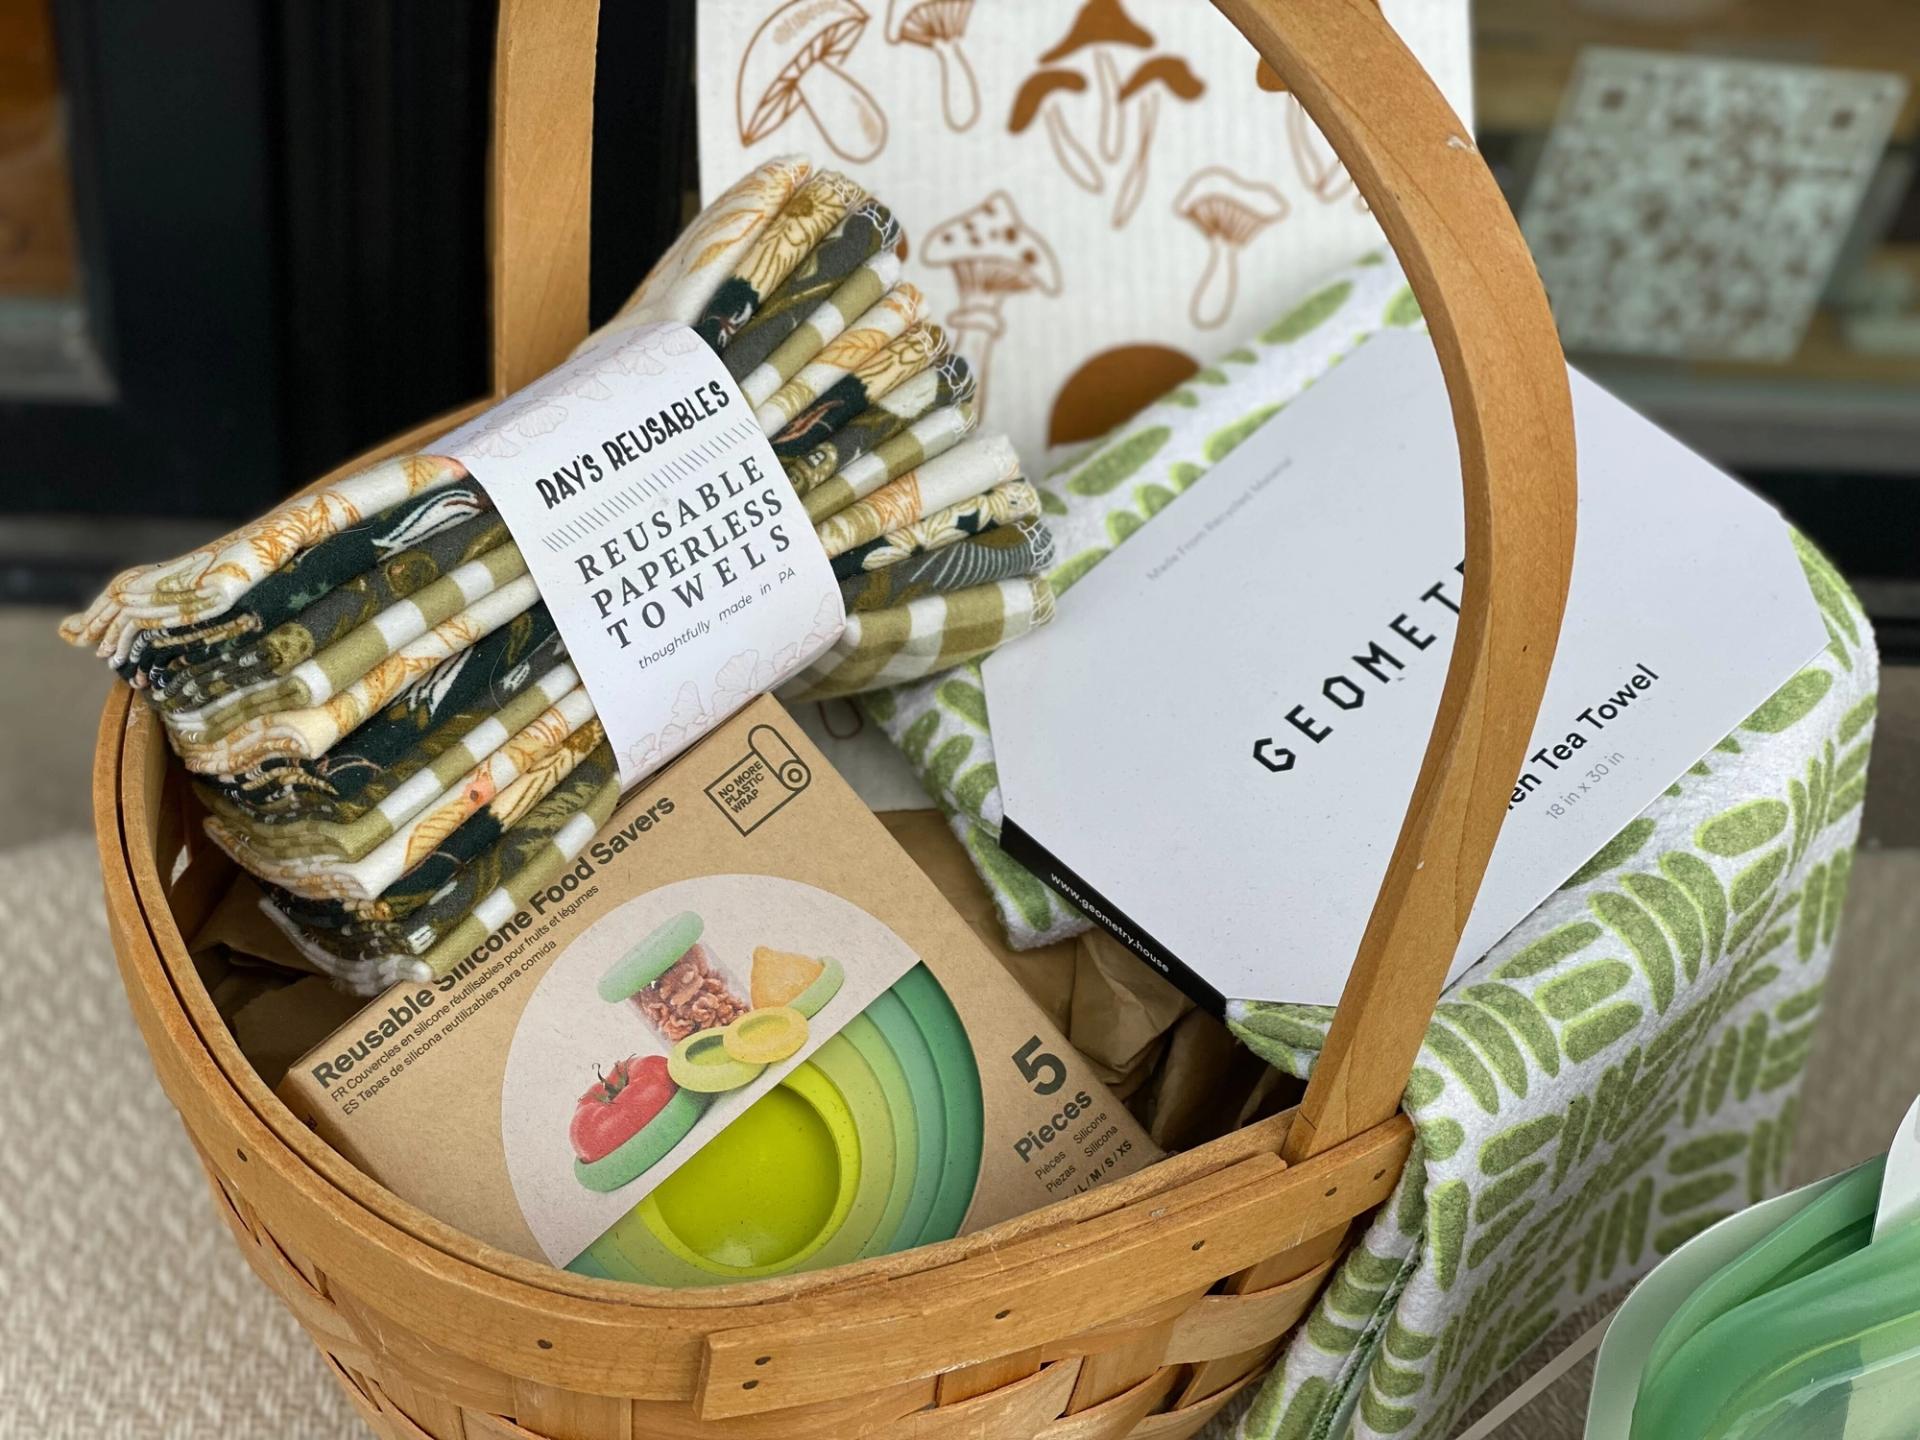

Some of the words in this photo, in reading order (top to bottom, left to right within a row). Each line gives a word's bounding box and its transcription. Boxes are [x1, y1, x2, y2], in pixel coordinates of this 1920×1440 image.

[535, 453, 604, 510] RAY'S
[602, 380, 730, 472] REUSABLES
[575, 456, 764, 585] REUSABLE
[591, 489, 783, 620] PAPERLESS
[606, 525, 790, 649] TOWELS
[638, 619, 711, 670] thoughtfully
[718, 594, 754, 621] made
[760, 582, 772, 597] in
[778, 567, 797, 585] PA
[1253, 560, 1466, 773] GEOMET
[1530, 732, 1588, 771] Tea
[1576, 662, 1660, 730] Towel
[718, 783, 735, 799] NO
[734, 761, 764, 787] MORE
[724, 773, 765, 806] PLASTIC
[731, 789, 760, 814] WRAP
[1545, 802, 1566, 820] 18
[1560, 791, 1580, 807] in
[1578, 782, 1592, 793] x
[1585, 763, 1610, 784] 30
[1606, 751, 1625, 767] in
[312, 987, 437, 1089] Reusable
[529, 859, 597, 915] Food
[590, 795, 675, 866] Savers
[1051, 872, 1170, 974] www.geometry.house
[331, 1085, 348, 1103] FR
[347, 1044, 401, 1090] Couvercles
[400, 1033, 414, 1050] en
[413, 1003, 451, 1040] silicone
[450, 960, 505, 1008] réutilisables
[503, 943, 526, 966] pour
[524, 923, 550, 947] fruits
[549, 915, 559, 927] et
[557, 883, 600, 923] légumes
[341, 1098, 360, 1115] ES
[357, 1075, 391, 1102] Tapas
[390, 1062, 405, 1077] de
[403, 1030, 443, 1066] silicona
[441, 982, 499, 1036] reutilizables
[498, 969, 522, 992] para
[520, 940, 557, 972] comida
[1011, 1034, 1067, 1096] 5
[1013, 1089, 1093, 1164] Pieces
[1045, 1164, 1077, 1193] Piezas
[1084, 1124, 1119, 1158] Silicona
[1073, 1111, 1108, 1145] Silicone
